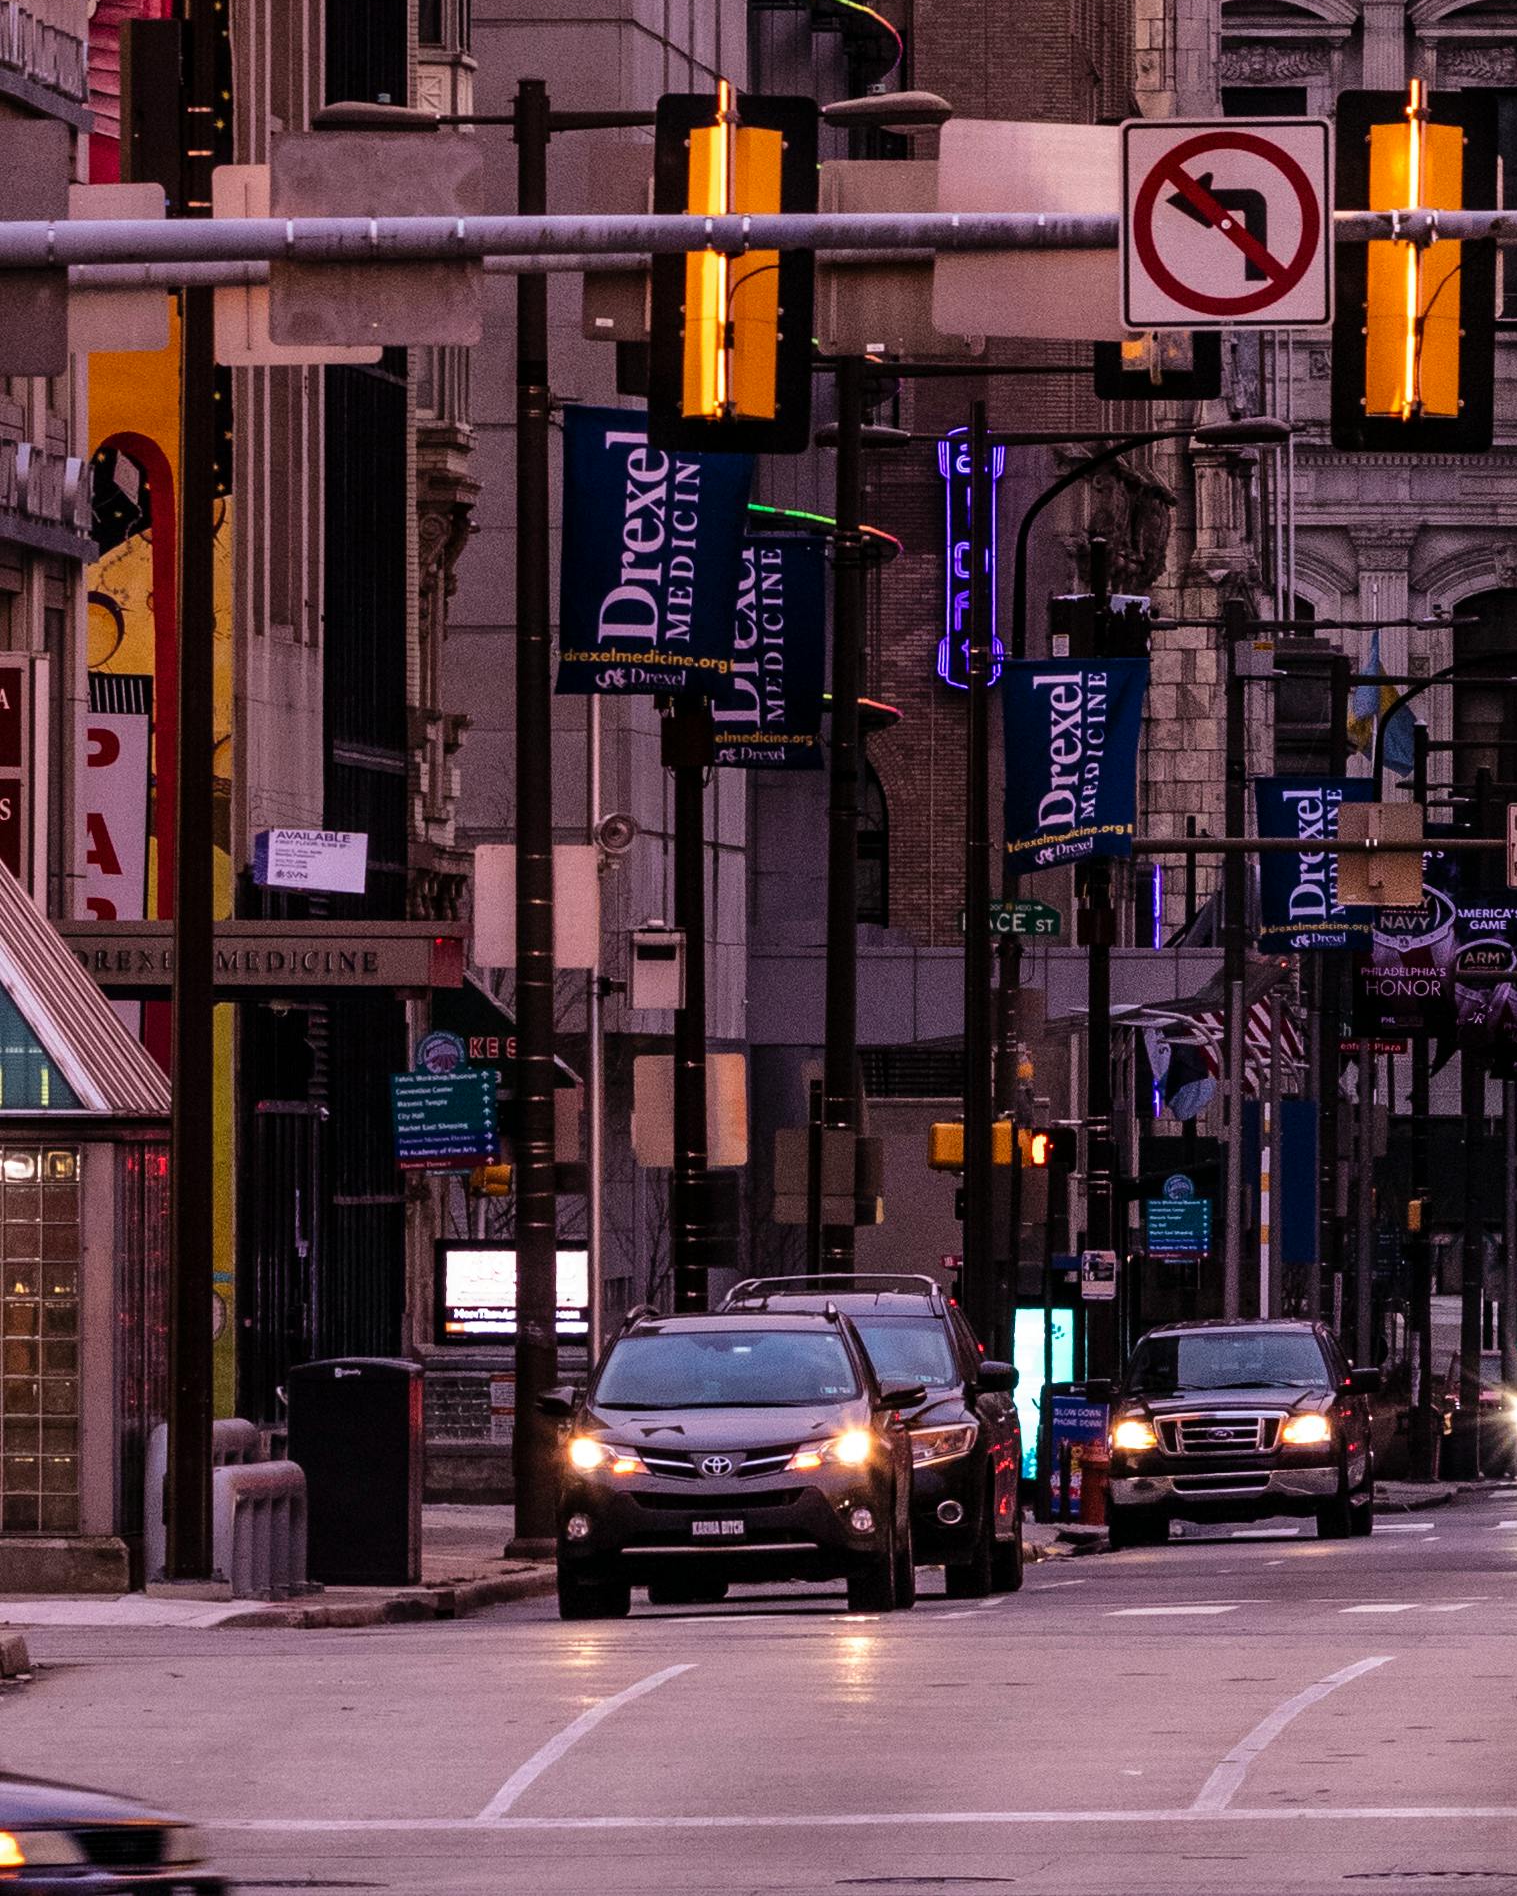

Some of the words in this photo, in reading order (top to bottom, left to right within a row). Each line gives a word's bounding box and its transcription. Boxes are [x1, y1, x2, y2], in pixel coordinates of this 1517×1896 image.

[597, 431, 669, 645] Drexel
[666, 461, 701, 642] MEDICIN
[762, 548, 784, 722] MEDICINE
[631, 668, 686, 686] Drexel
[740, 746, 785, 760] Drexel
[1033, 671, 1083, 828] Drexel
[1080, 672, 1107, 818] MEDICINE
[276, 830, 351, 844] AVAILABLE
[1056, 837, 1094, 855] Drexel
[1035, 918, 1055, 932] ST
[1381, 916, 1430, 930] NAVY
[1470, 920, 1507, 930] GAME
[1312, 932, 1346, 944] Drexel
[217, 950, 378, 973] MEDICINE
[1366, 980, 1441, 997] HONOR
[722, 1520, 744, 1534] BITCH
